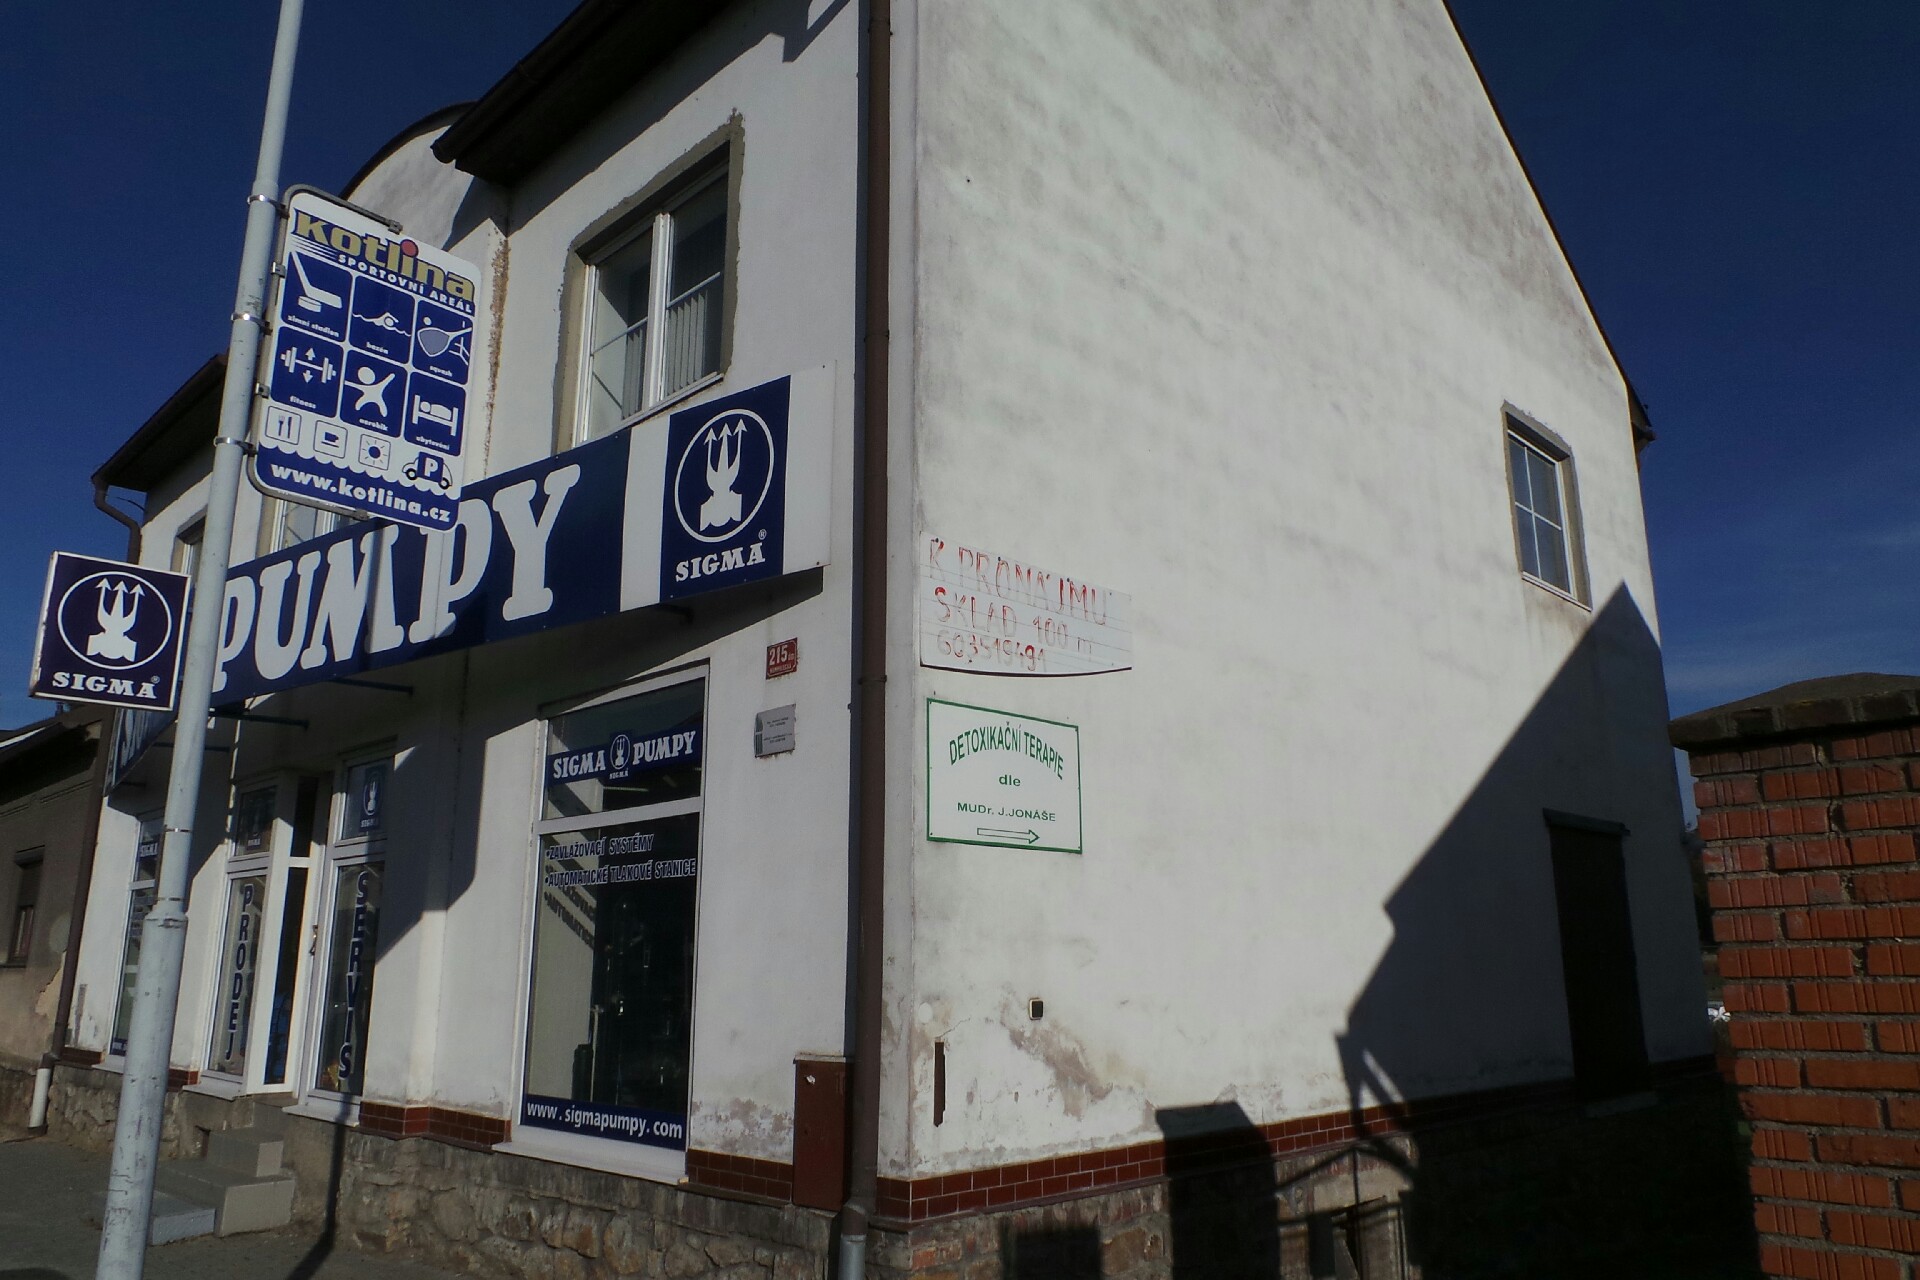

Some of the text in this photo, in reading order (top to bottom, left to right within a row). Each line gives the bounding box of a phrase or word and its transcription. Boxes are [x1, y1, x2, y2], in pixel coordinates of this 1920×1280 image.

[339, 254, 472, 313] SPORTOVNÍ AREÁL
[289, 395, 317, 409] fitness
[359, 418, 389, 432] aerobik
[425, 459, 438, 476] P
[271, 463, 451, 523] www.kotlina.cz
[212, 464, 581, 693] PUMPY
[675, 542, 766, 582] SIGMA
[929, 538, 946, 580] K
[934, 586, 1017, 638] SKLAD
[769, 644, 788, 667] 215
[52, 671, 158, 699] SIGMA
[553, 731, 696, 780] SIGMA PUMPY
[949, 721, 1064, 780] DETOXIKAČNÍ TERAPIE
[999, 774, 1021, 787] dle
[957, 802, 995, 815] MUDr.
[609, 831, 655, 856] SYSTÉMY
[548, 858, 696, 887] AUTOMATICKÉ TLAKOVÉ STANICE
[225, 884, 254, 1061] PRODEJ
[338, 870, 369, 1081] SERVIS
